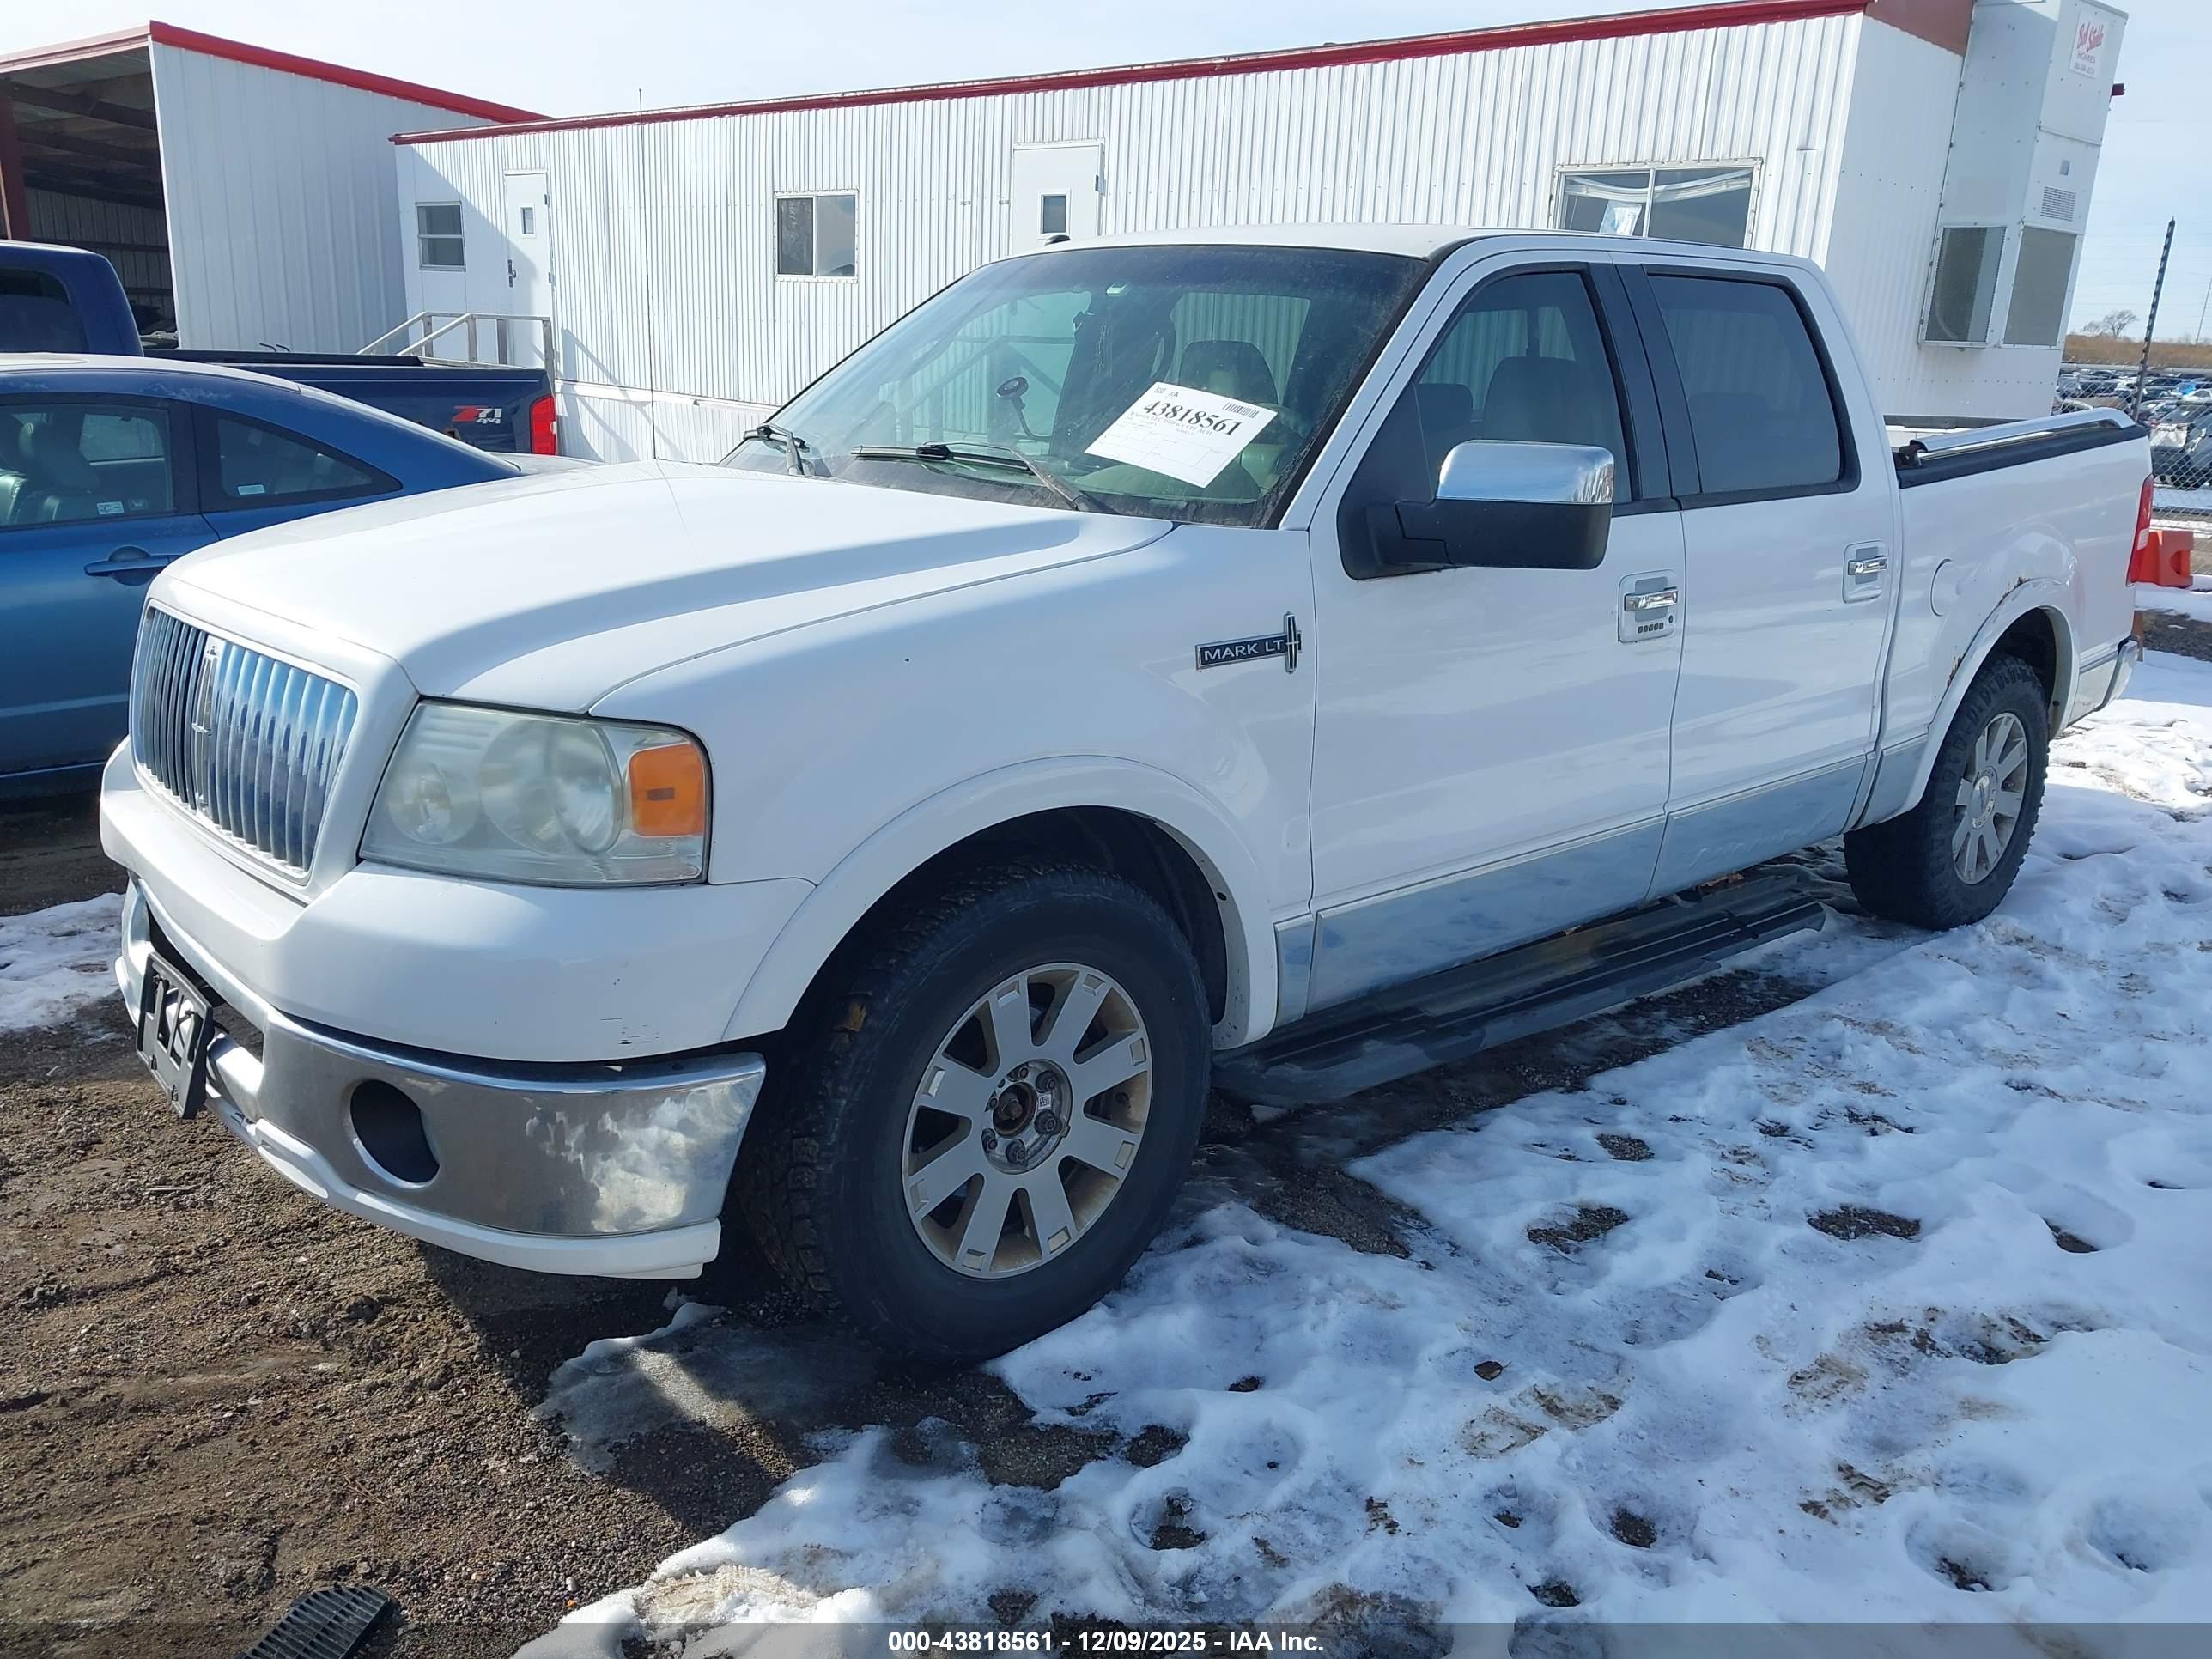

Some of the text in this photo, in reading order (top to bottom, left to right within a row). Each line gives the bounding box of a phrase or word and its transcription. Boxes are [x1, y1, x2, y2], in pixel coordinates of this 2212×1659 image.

[453, 405, 502, 422] Z71
[1143, 400, 1243, 435] 43818561
[1205, 639, 1284, 661] MARK LT
